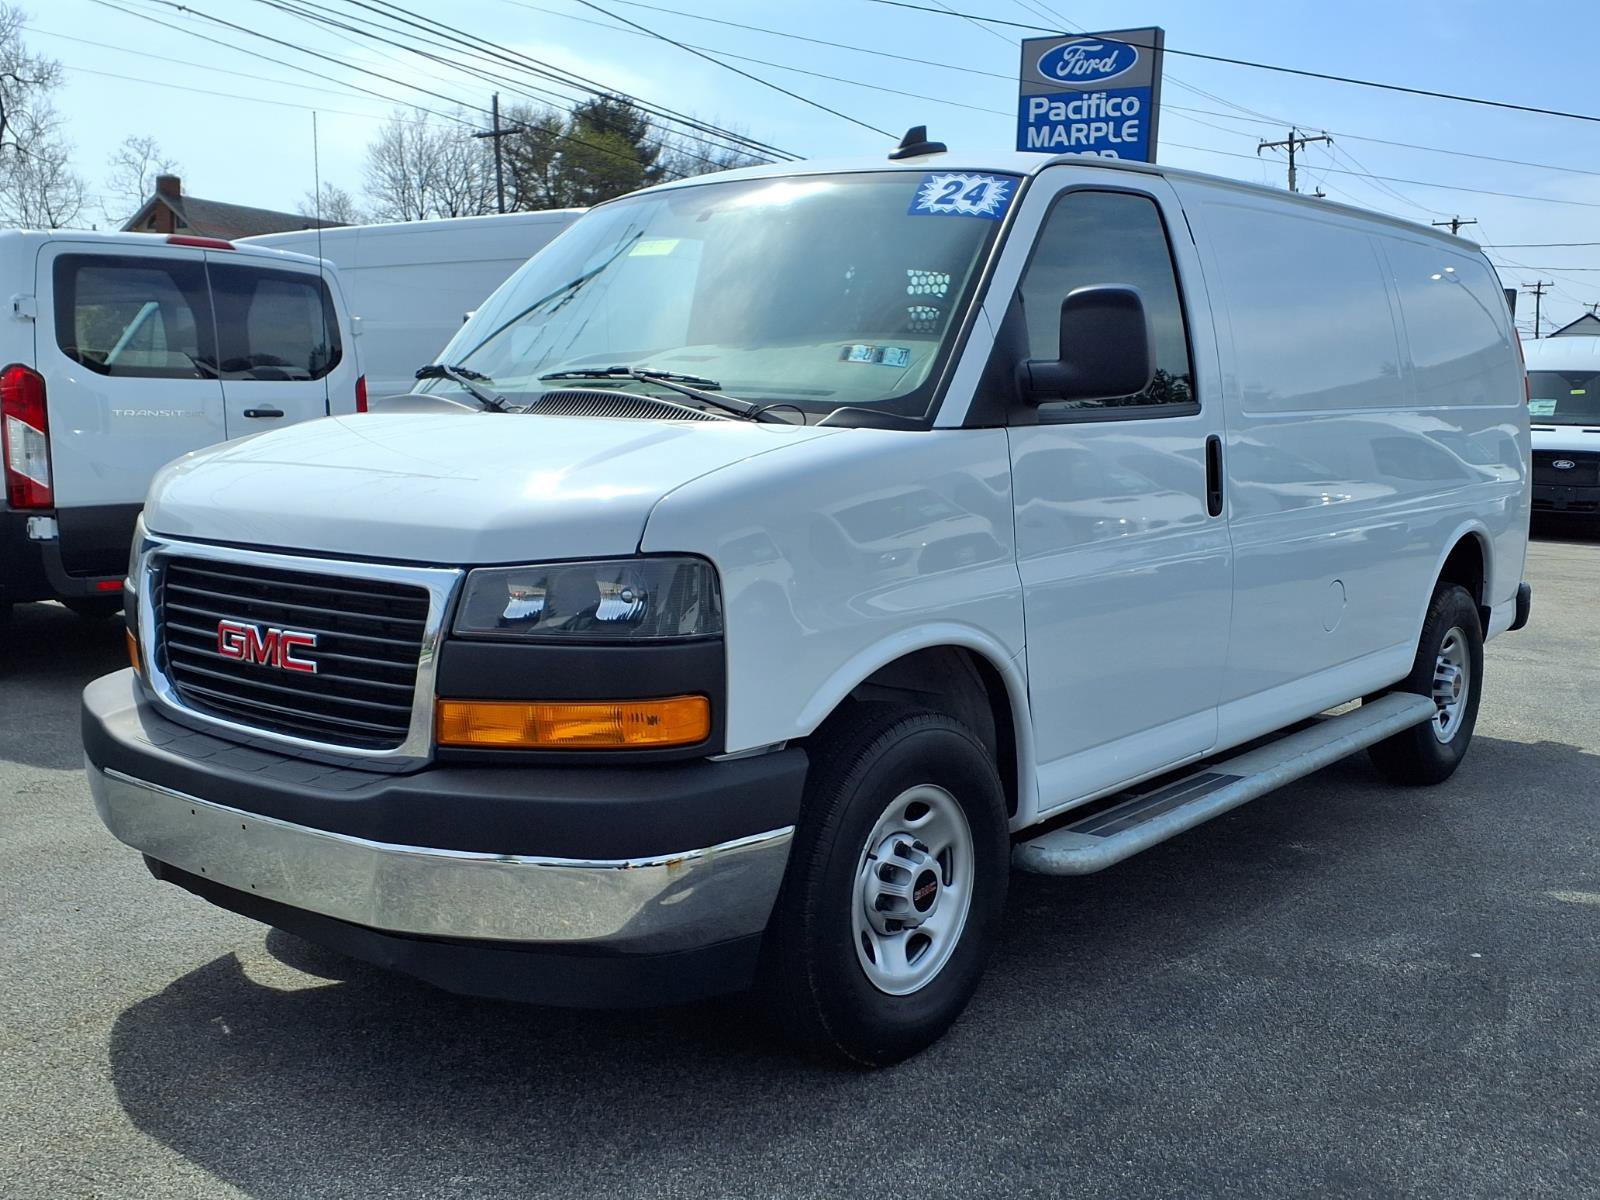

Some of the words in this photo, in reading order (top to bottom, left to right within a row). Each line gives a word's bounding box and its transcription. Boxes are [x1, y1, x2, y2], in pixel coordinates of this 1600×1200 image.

[1056, 45, 1119, 77] Ford
[1028, 92, 1140, 122] Pacifico
[1027, 120, 1139, 148] MARPLE
[933, 180, 989, 207] 24
[217, 620, 318, 674] GMC
